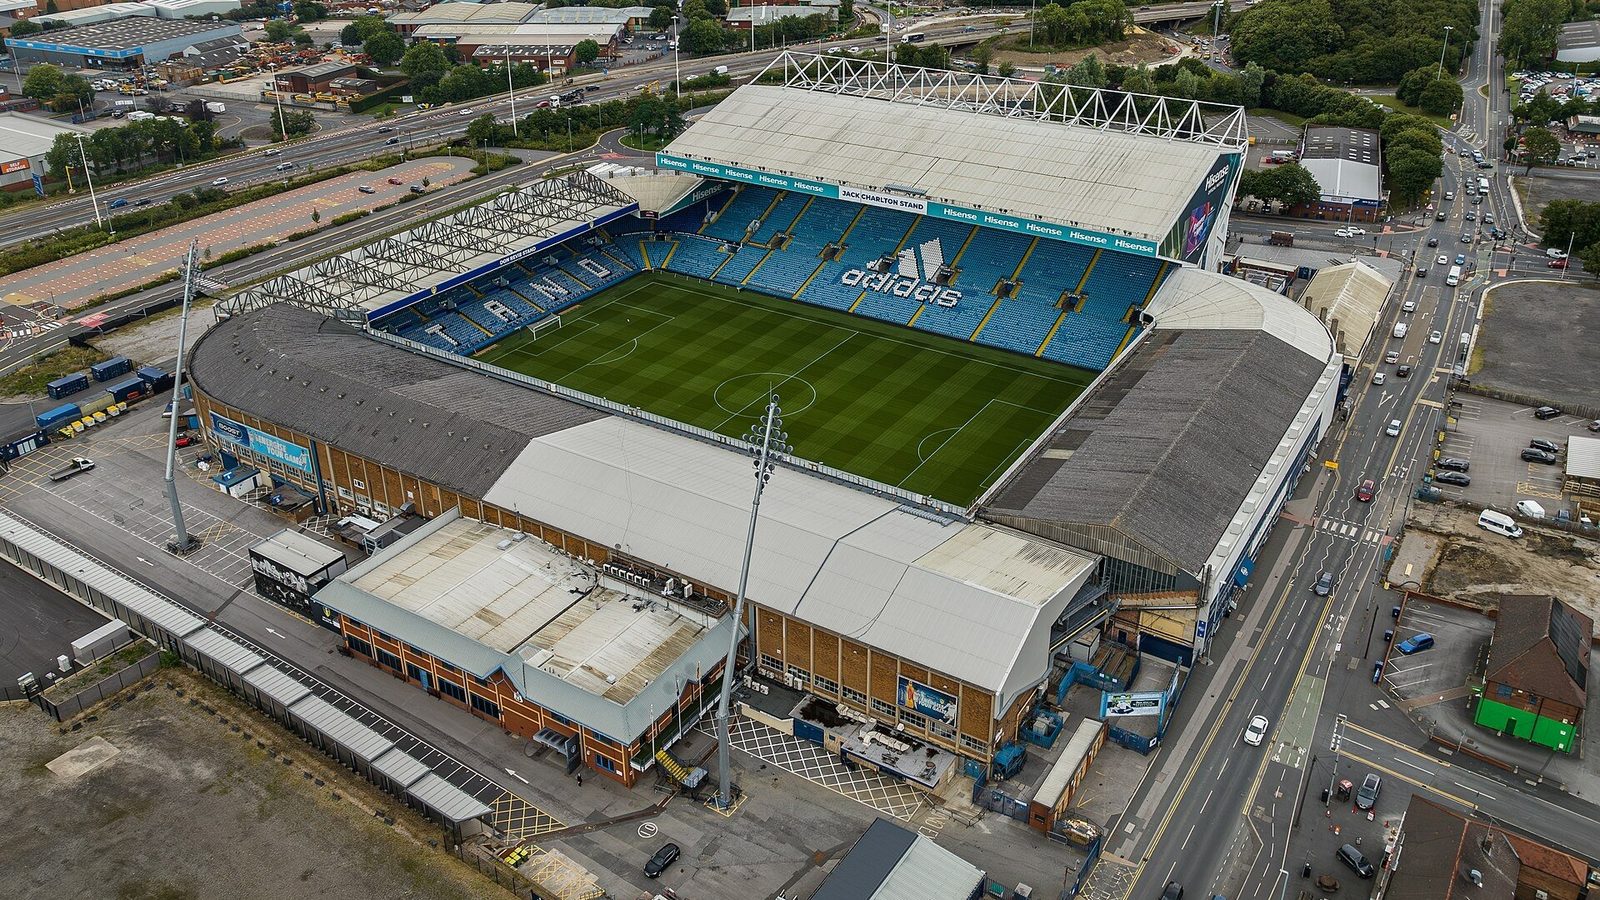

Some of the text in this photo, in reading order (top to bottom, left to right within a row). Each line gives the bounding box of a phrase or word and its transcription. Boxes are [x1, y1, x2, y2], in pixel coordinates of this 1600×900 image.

[661, 158, 687, 168] Hisense
[692, 163, 720, 173] Hisense
[725, 169, 753, 180] Hisense
[759, 175, 787, 186] Hisense
[1204, 164, 1229, 191] Hisense
[692, 183, 722, 201] Hisense
[794, 181, 824, 192] Hisense
[842, 190, 924, 210] JACK CHARLTON STAND
[943, 208, 977, 221] Hisense
[984, 215, 1019, 228] Hisense
[1026, 222, 1063, 236] Hisense
[1069, 231, 1108, 245] Hisense
[1114, 239, 1154, 253] Hisense
[841, 268, 962, 308] adidas
[217, 422, 240, 437] BOOST
[267, 444, 285, 460] YOUR
